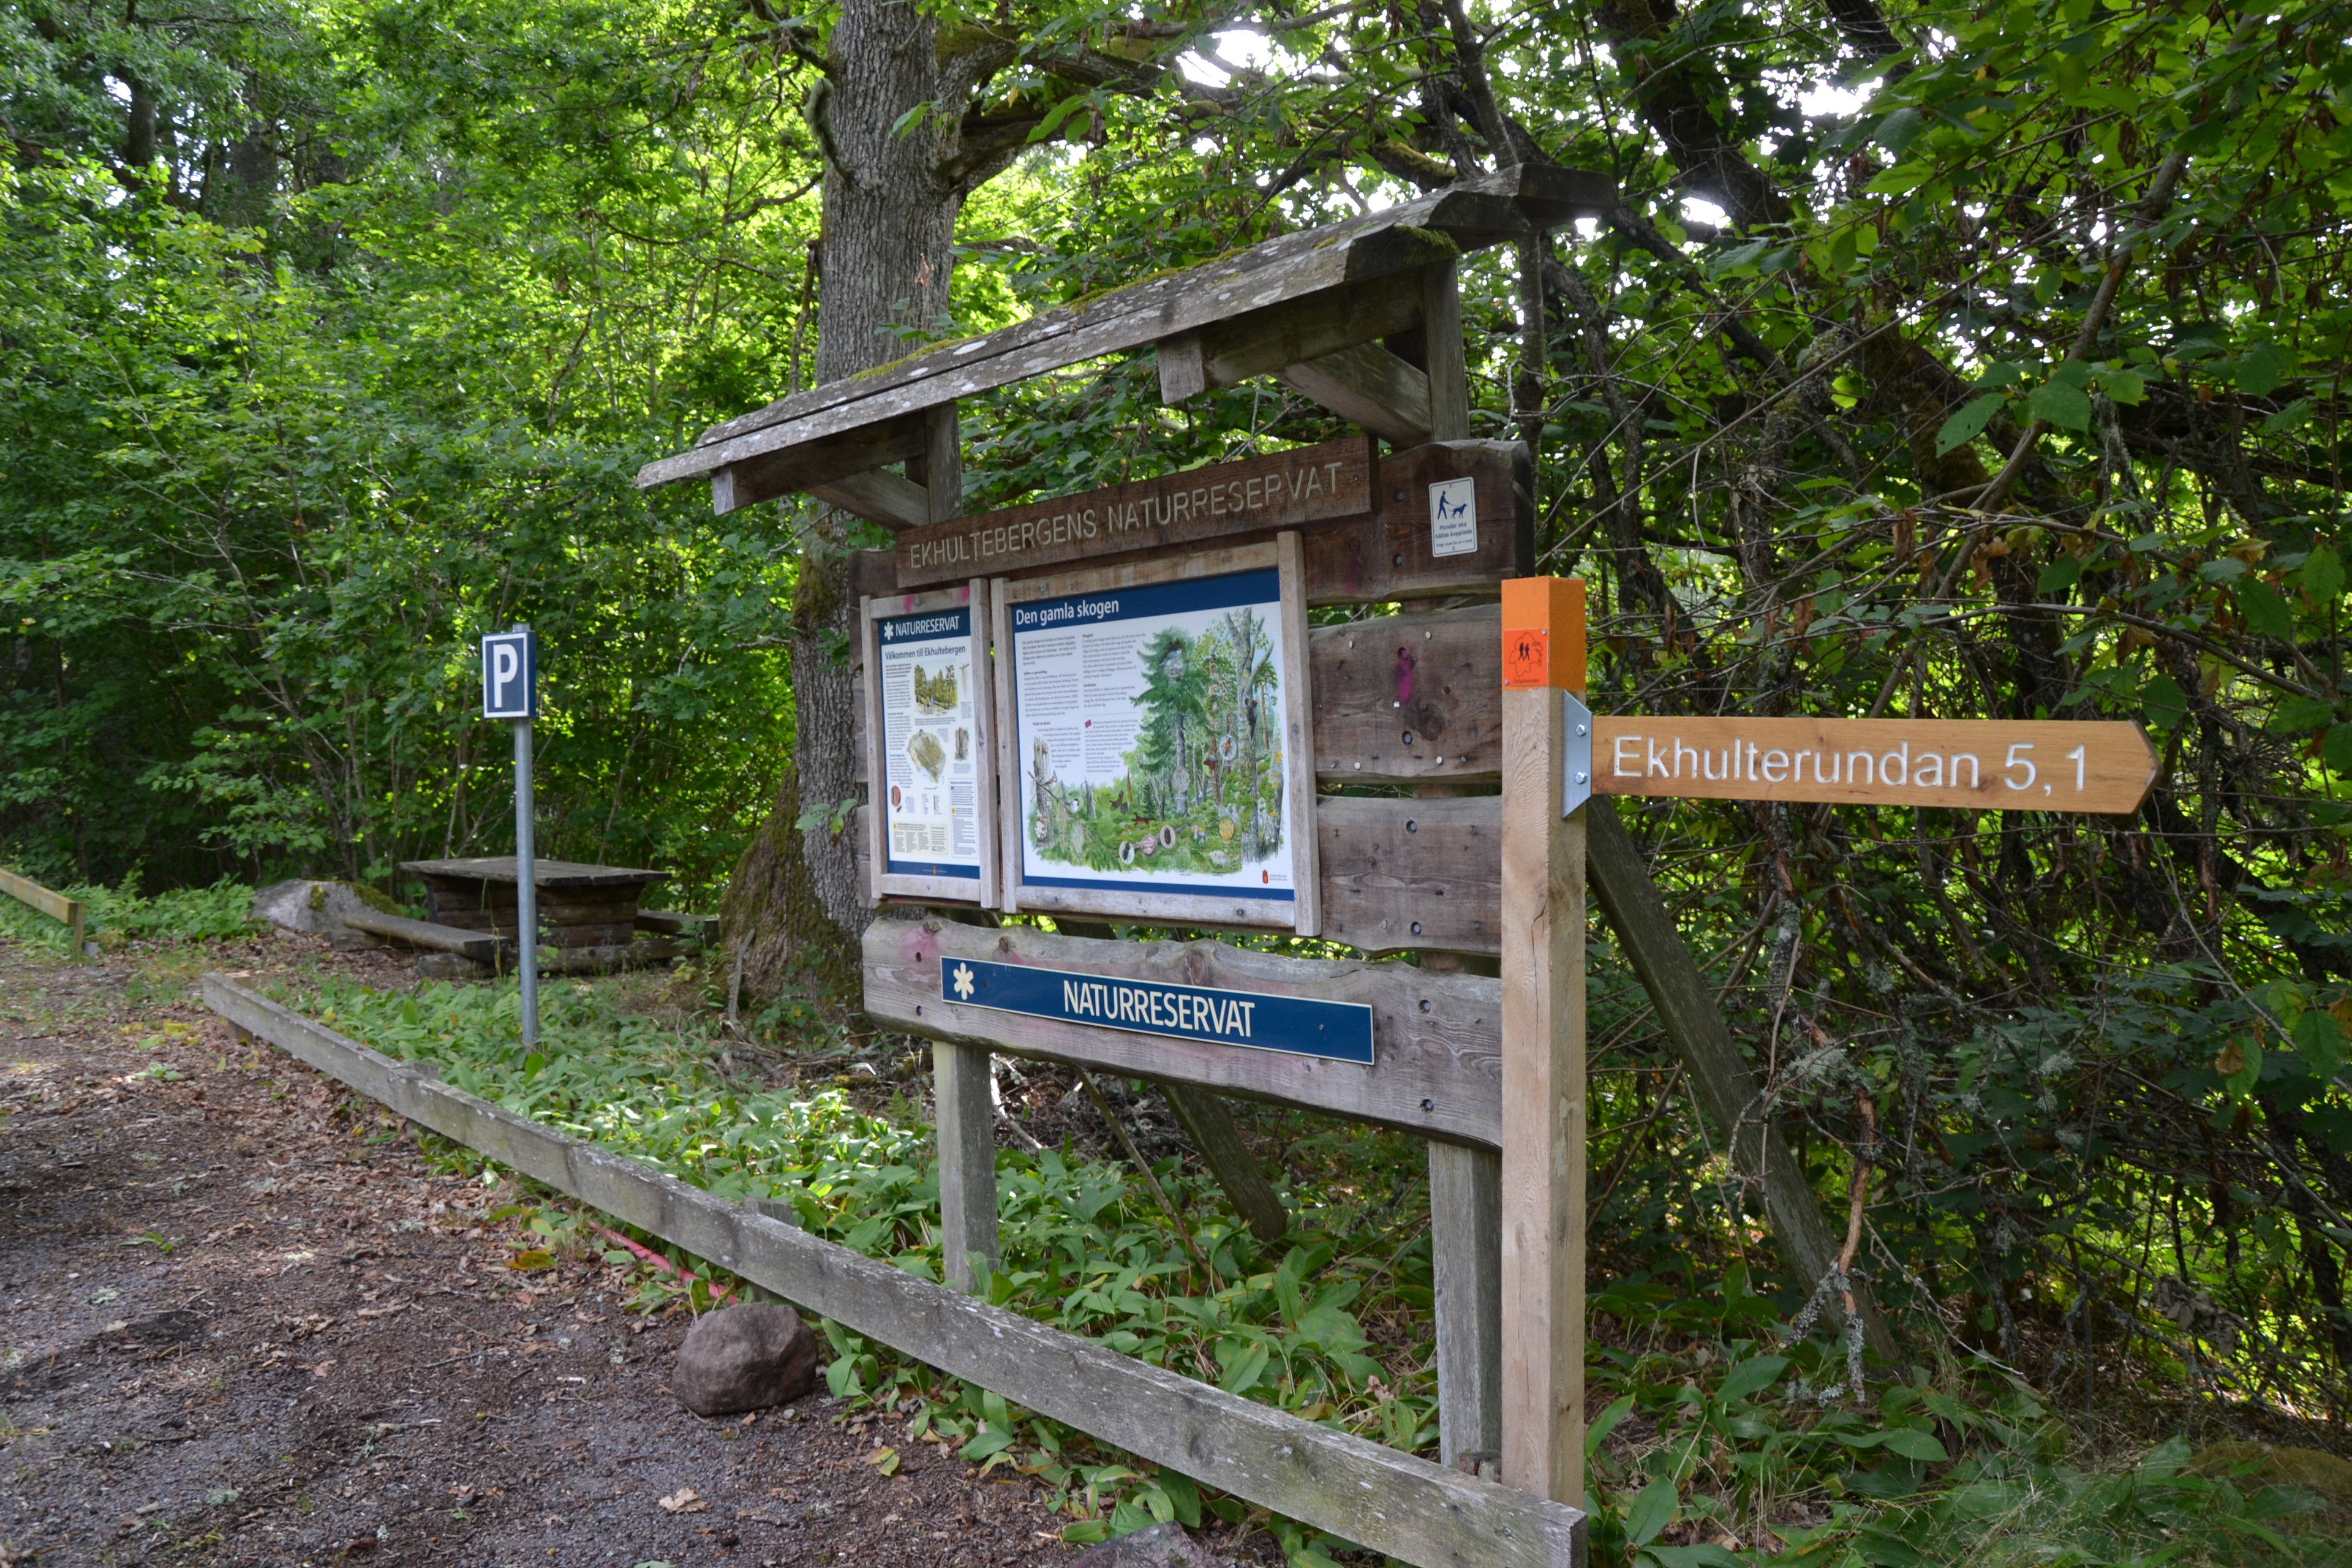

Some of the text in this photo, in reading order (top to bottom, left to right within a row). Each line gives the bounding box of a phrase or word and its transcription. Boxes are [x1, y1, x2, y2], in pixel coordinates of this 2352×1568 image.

[910, 462, 1342, 569] EKHULTEBERGENS NATURRESERVAT
[895, 616, 959, 636] NATURRESERVAT
[1016, 600, 1119, 626] Den gamla skogen
[494, 644, 518, 707] P
[885, 651, 916, 660] Välkommen
[925, 645, 965, 657] Ekhultebergen
[1613, 736, 1978, 788] Ekhulterundan
[1065, 980, 1254, 1036] NATURRESERVAT
